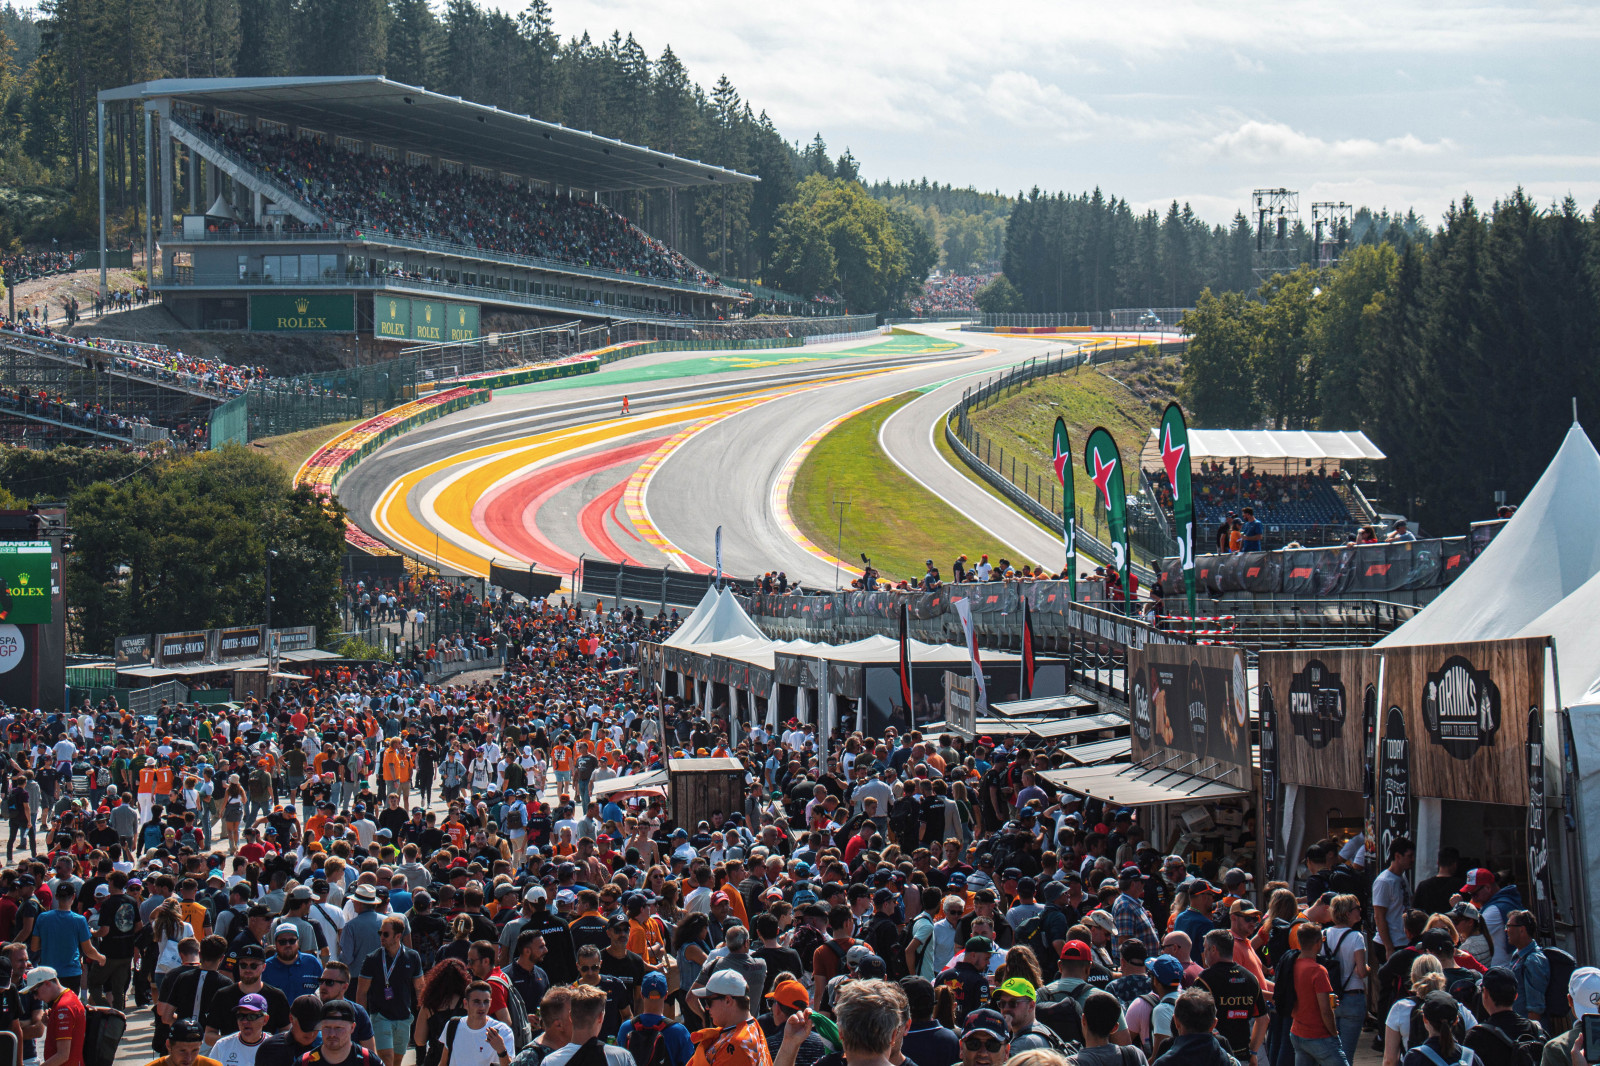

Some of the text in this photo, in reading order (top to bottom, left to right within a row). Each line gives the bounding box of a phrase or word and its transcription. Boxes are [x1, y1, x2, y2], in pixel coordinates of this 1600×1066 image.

[277, 317, 327, 328] ROLEX
[381, 321, 405, 336] ROLEX
[417, 325, 440, 339] ROLEX
[452, 328, 473, 341] ROLEX
[0, 636, 17, 645] SPA
[221, 636, 259, 650] FRITES SNACKS
[0, 645, 17, 657] GP
[126, 646, 142, 655] SNACKS
[163, 641, 205, 656] FRITES SNACKS
[1438, 665, 1478, 717] DRINKS
[1291, 692, 1313, 715] PIZZA
[1386, 739, 1405, 760] TODAY
[144, 772, 149, 783] 1
[163, 772, 168, 783] 1
[1385, 778, 1407, 795] PERFECT
[1385, 790, 1406, 815] DAY
[540, 926, 564, 935] TRONAS
[1087, 975, 1110, 983] RONAS
[1219, 995, 1254, 1006] LOTUS
